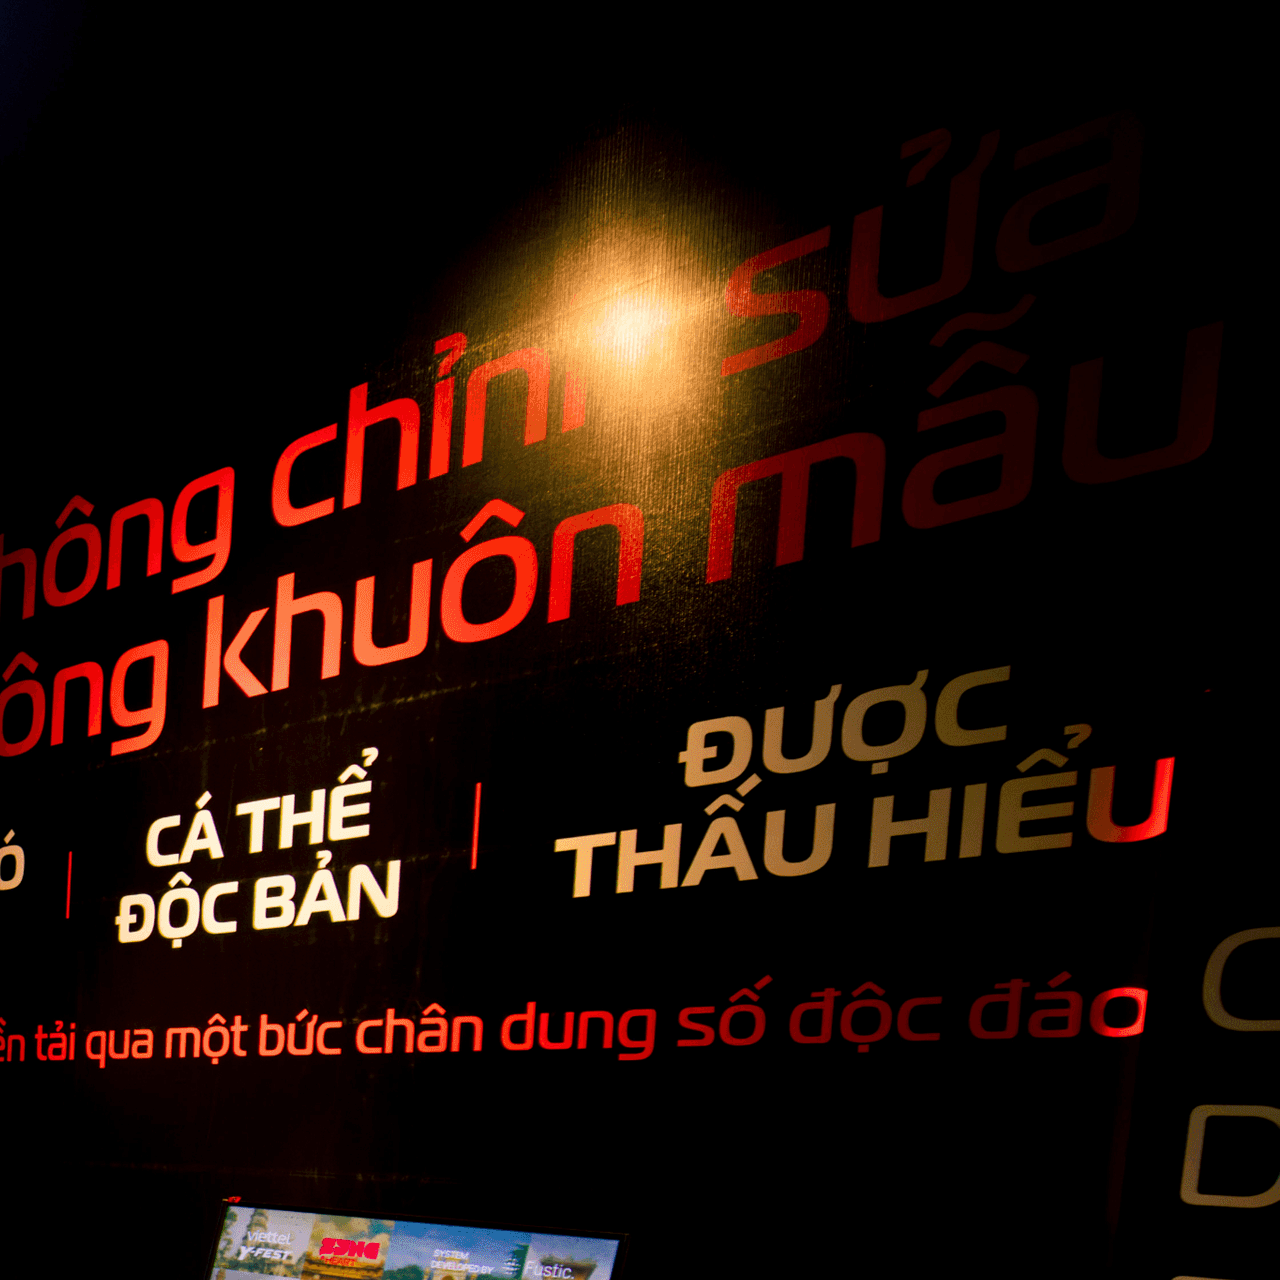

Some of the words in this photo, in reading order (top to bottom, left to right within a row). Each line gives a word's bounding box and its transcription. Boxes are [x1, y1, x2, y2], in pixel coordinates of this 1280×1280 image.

[270, 333, 588, 529] chỉn
[720, 108, 1145, 376] sửa
[202, 497, 643, 709] khuôn
[704, 294, 1224, 586] mẫu
[677, 665, 1011, 788] ĐƯỢC
[145, 790, 224, 867] CÁ
[235, 747, 379, 854] THỂ
[553, 773, 836, 899] THẤU
[867, 723, 1176, 869] HIỂU
[114, 870, 240, 949] ĐỘC
[252, 850, 402, 931] BẢN
[34, 1019, 76, 1062] tải
[86, 1028, 154, 1069] qua
[165, 1013, 248, 1065] một
[258, 1009, 343, 1057] bức
[355, 1002, 485, 1056] chân
[499, 1001, 657, 1061] dung
[676, 974, 774, 1048] số
[789, 981, 942, 1054] độc
[968, 970, 1149, 1041] đáo
